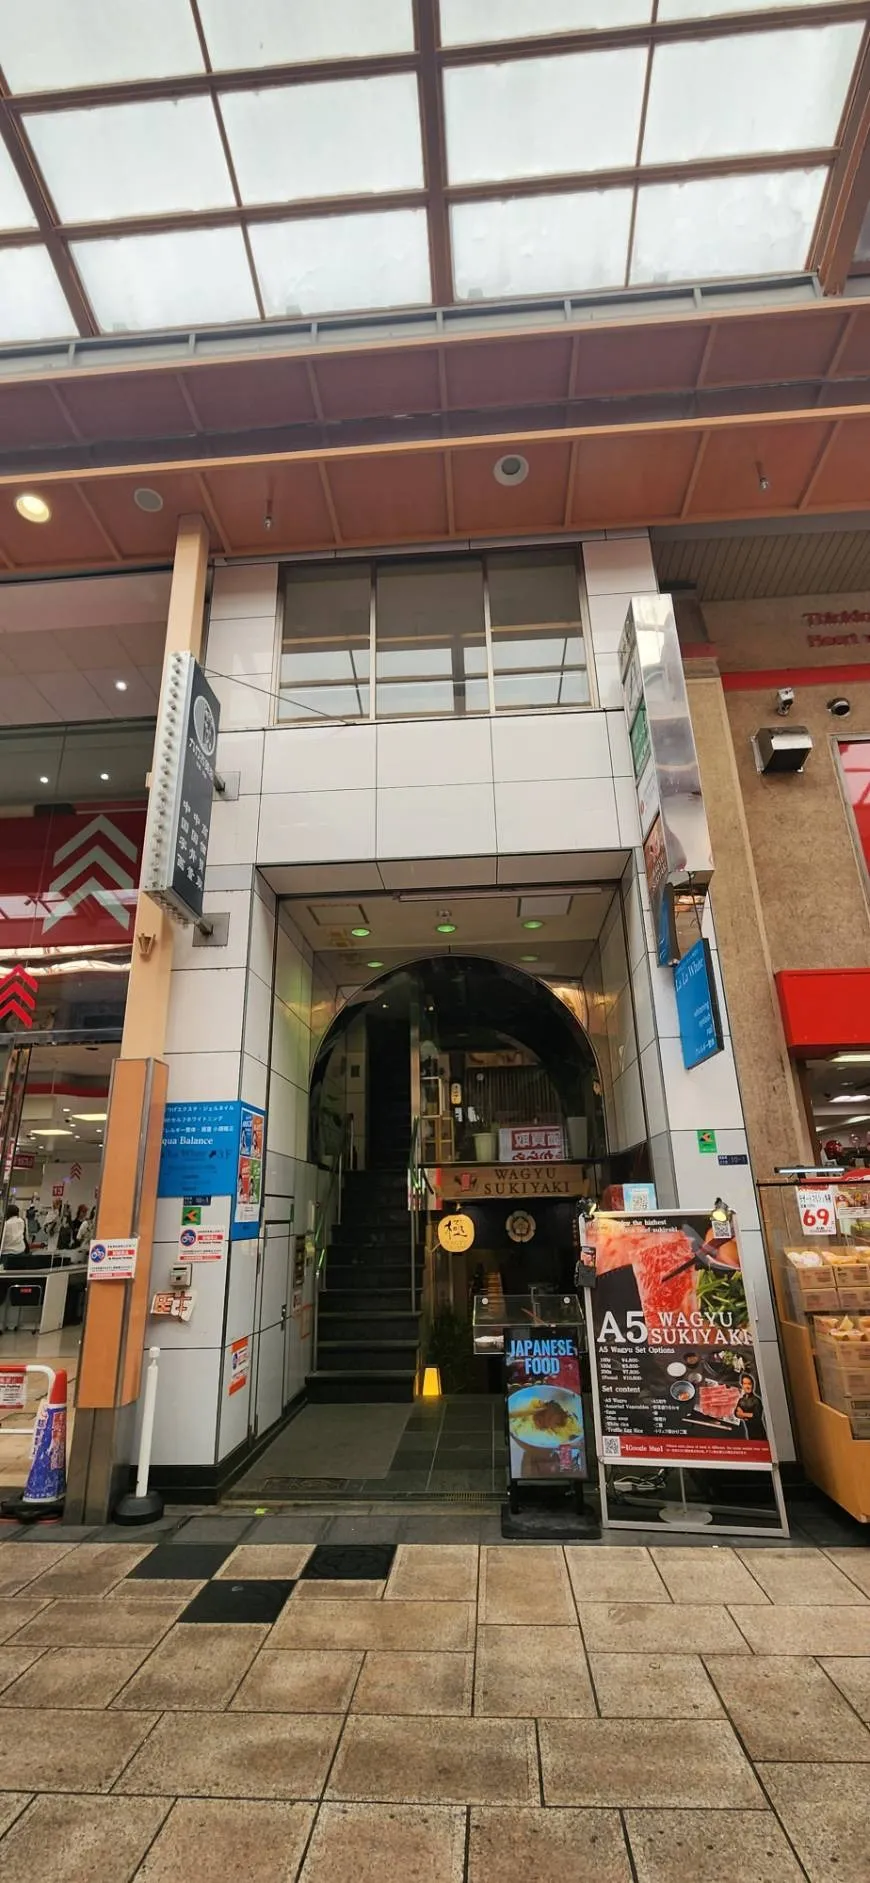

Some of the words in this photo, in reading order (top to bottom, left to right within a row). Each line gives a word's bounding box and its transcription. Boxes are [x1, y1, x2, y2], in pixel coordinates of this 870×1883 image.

[161, 1138, 178, 1146] qua
[179, 1135, 214, 1145] Balance
[493, 1168, 558, 1180] WAGYU
[484, 1181, 570, 1195] SUKIYAKI
[644, 1218, 667, 1226] highest
[803, 1208, 830, 1227] 69
[596, 1310, 648, 1344] A5
[657, 1311, 734, 1328] WAGYU
[651, 1328, 751, 1346] SUKIYAKI
[509, 1339, 575, 1357] JAPANESE
[610, 1346, 633, 1354] Wagyu
[635, 1346, 646, 1354] Set
[648, 1346, 676, 1354] Options
[524, 1357, 560, 1376] FOOD
[601, 1385, 613, 1393] Set
[615, 1385, 641, 1393] content
